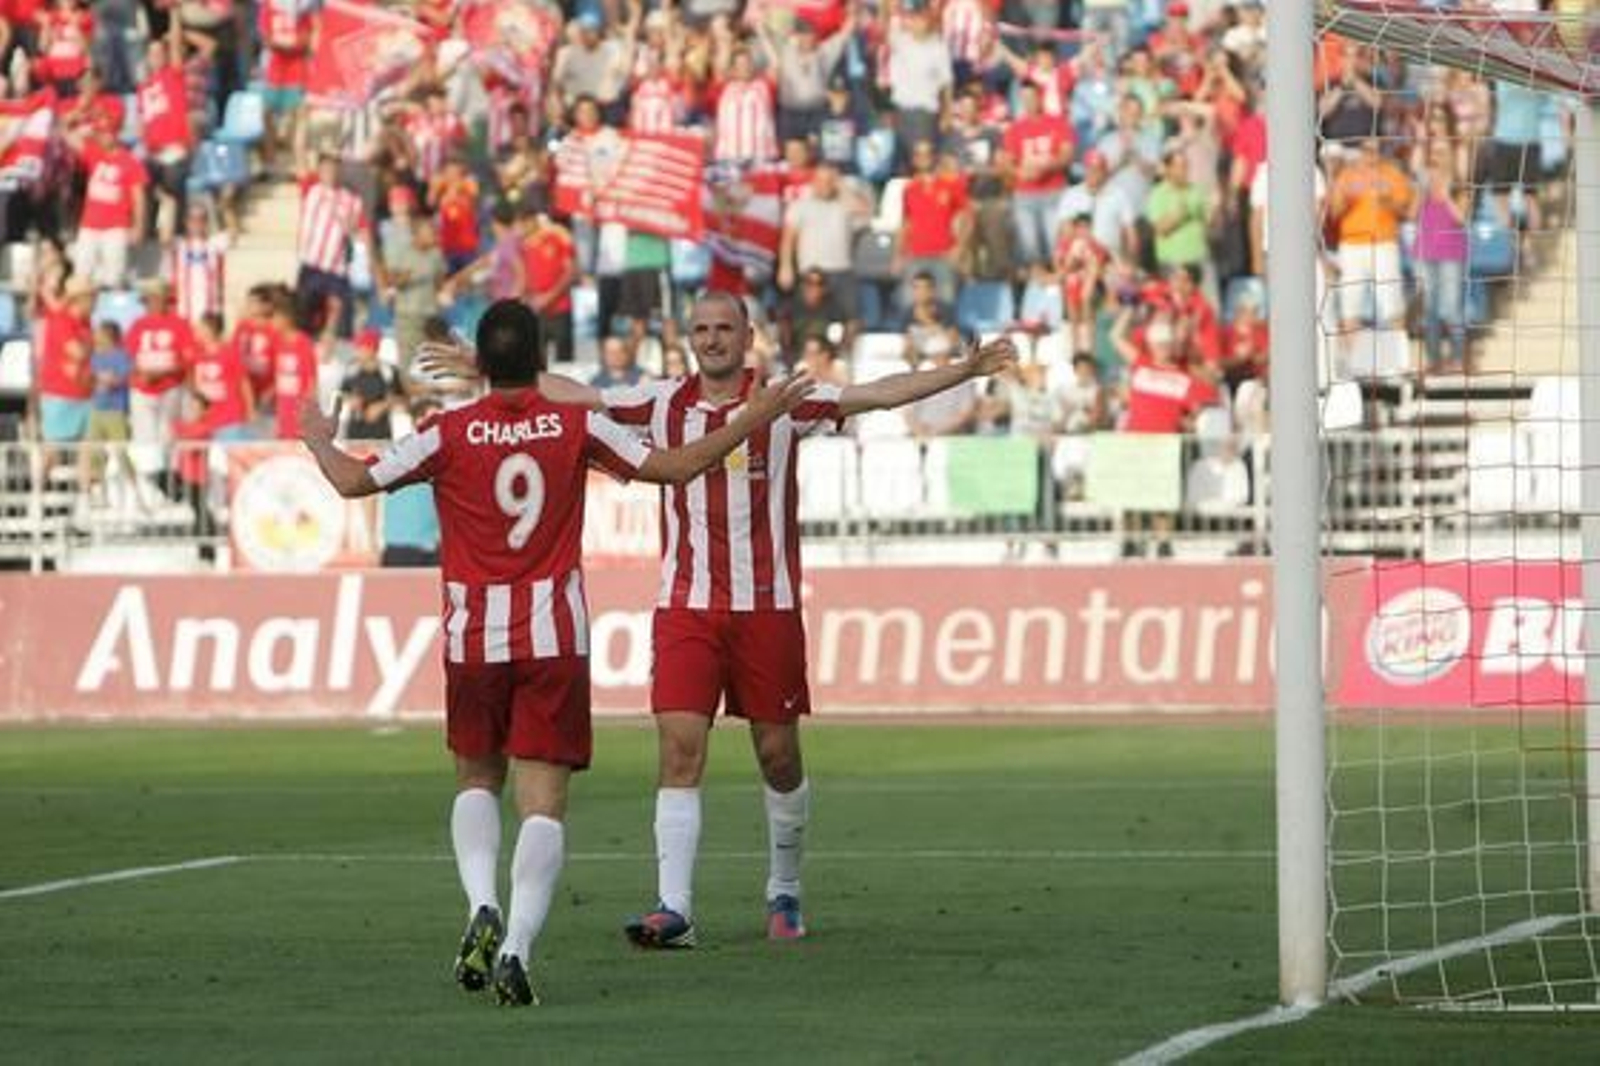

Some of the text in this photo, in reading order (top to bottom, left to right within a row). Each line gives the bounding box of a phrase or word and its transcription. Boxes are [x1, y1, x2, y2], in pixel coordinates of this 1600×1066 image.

[466, 412, 563, 445] CHARLES
[494, 451, 546, 550] 9
[75, 573, 655, 718] Analya
